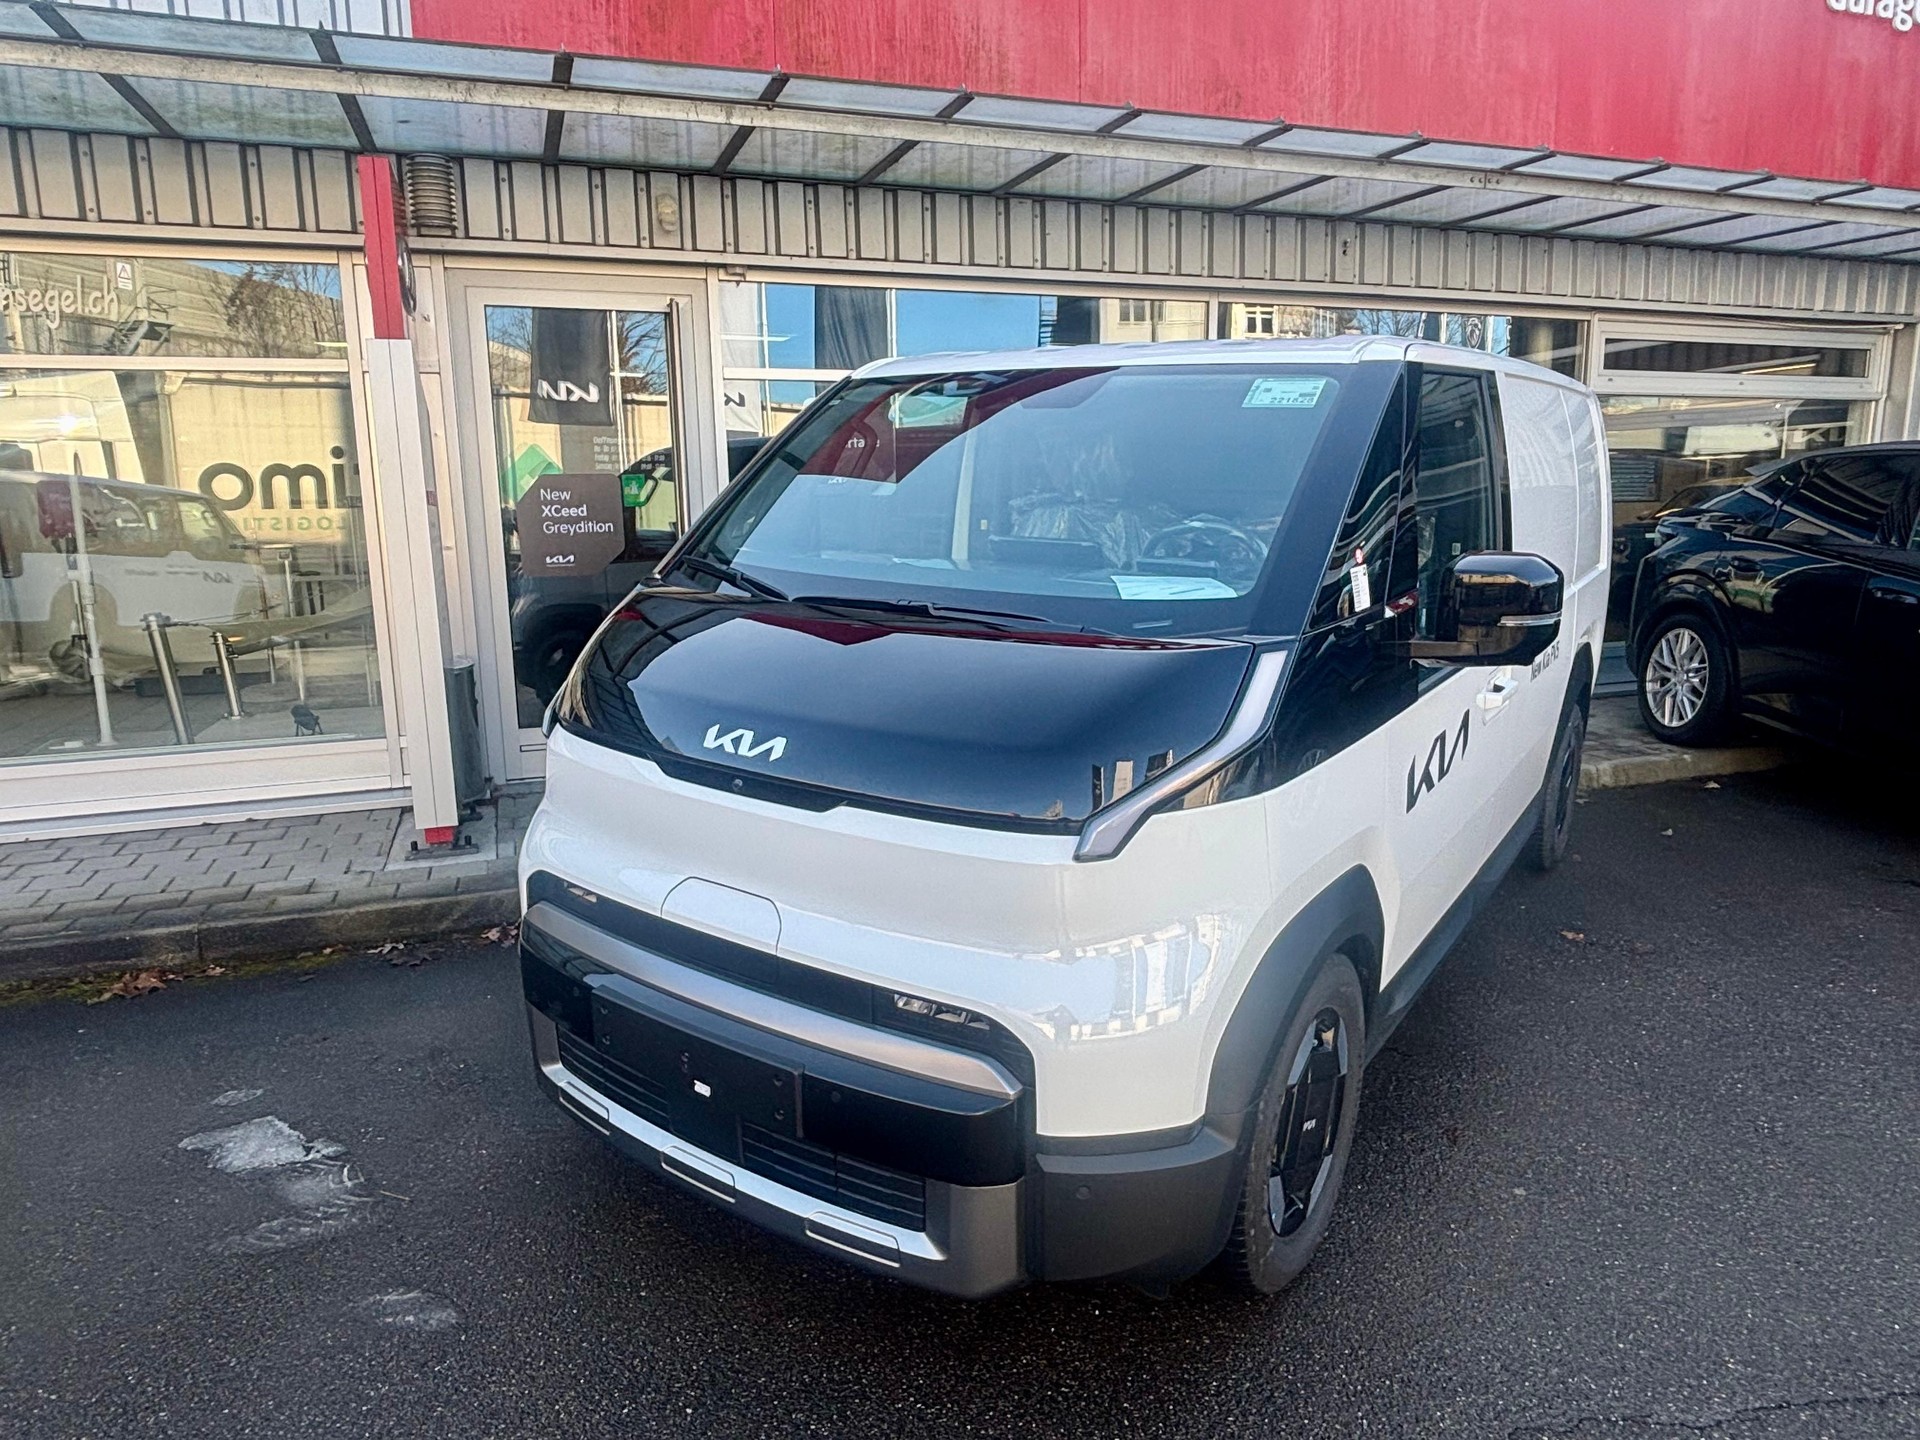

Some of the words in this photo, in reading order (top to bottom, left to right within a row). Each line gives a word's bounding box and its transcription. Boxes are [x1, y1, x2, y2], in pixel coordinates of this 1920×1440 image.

[540, 488, 571, 501] New
[541, 504, 587, 517] XCeed
[543, 520, 614, 536] Greydition
[703, 724, 787, 761] KIA
[1406, 708, 1469, 814] KIA
